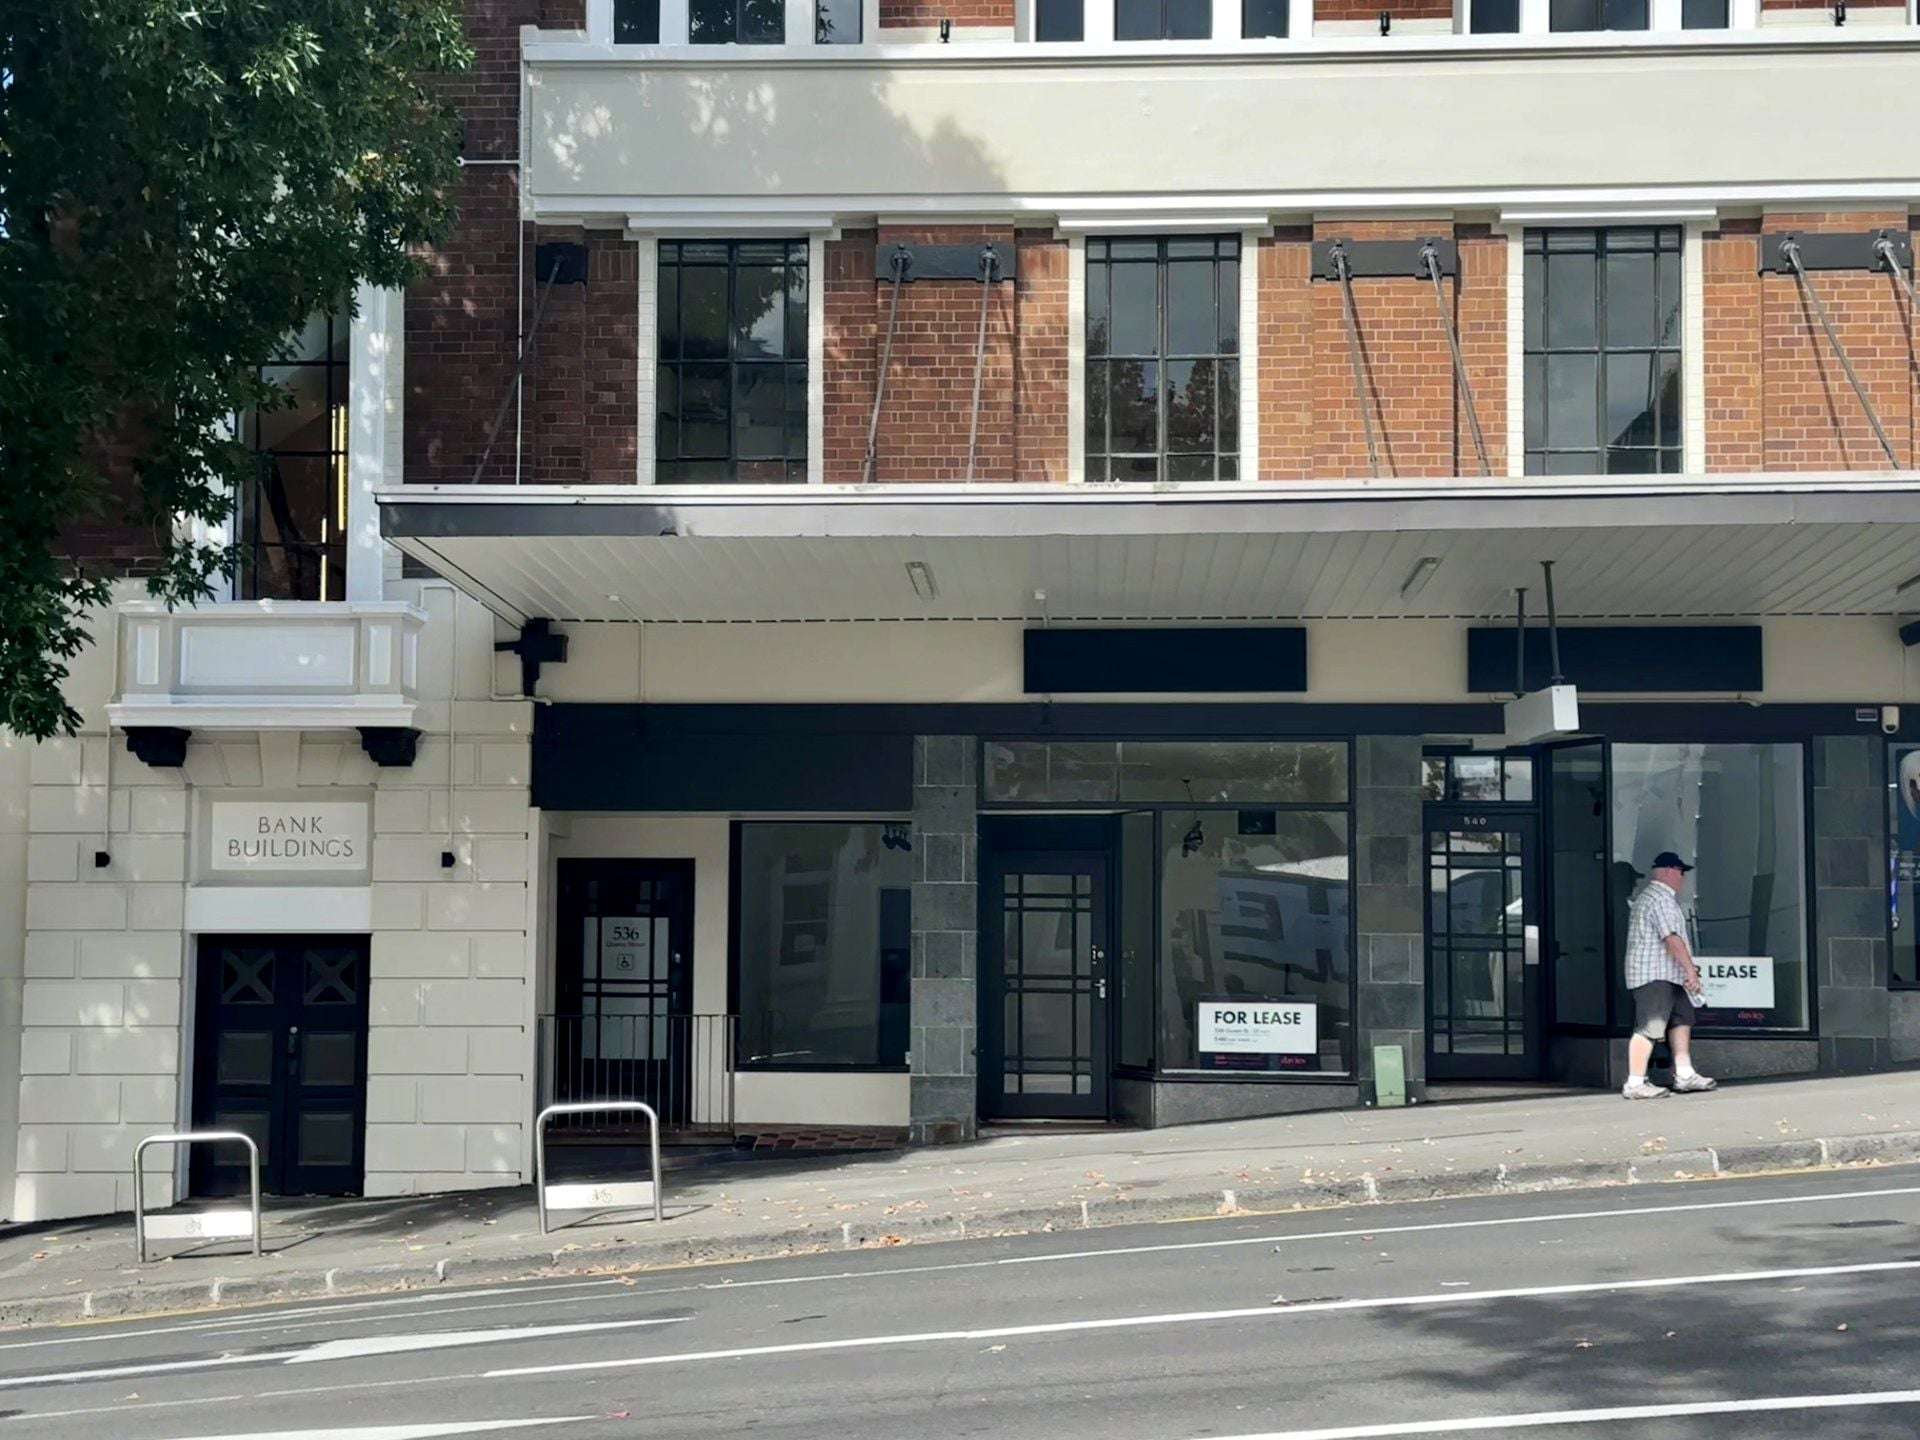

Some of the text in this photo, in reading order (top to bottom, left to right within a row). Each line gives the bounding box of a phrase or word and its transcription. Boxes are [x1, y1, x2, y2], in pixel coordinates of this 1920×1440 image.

[257, 816, 323, 834] BANK
[228, 839, 354, 858] BUILDINGS
[612, 926, 640, 941] 536
[1708, 965, 1758, 979] LEASE
[1214, 1011, 1301, 1025] FOR LEASE
